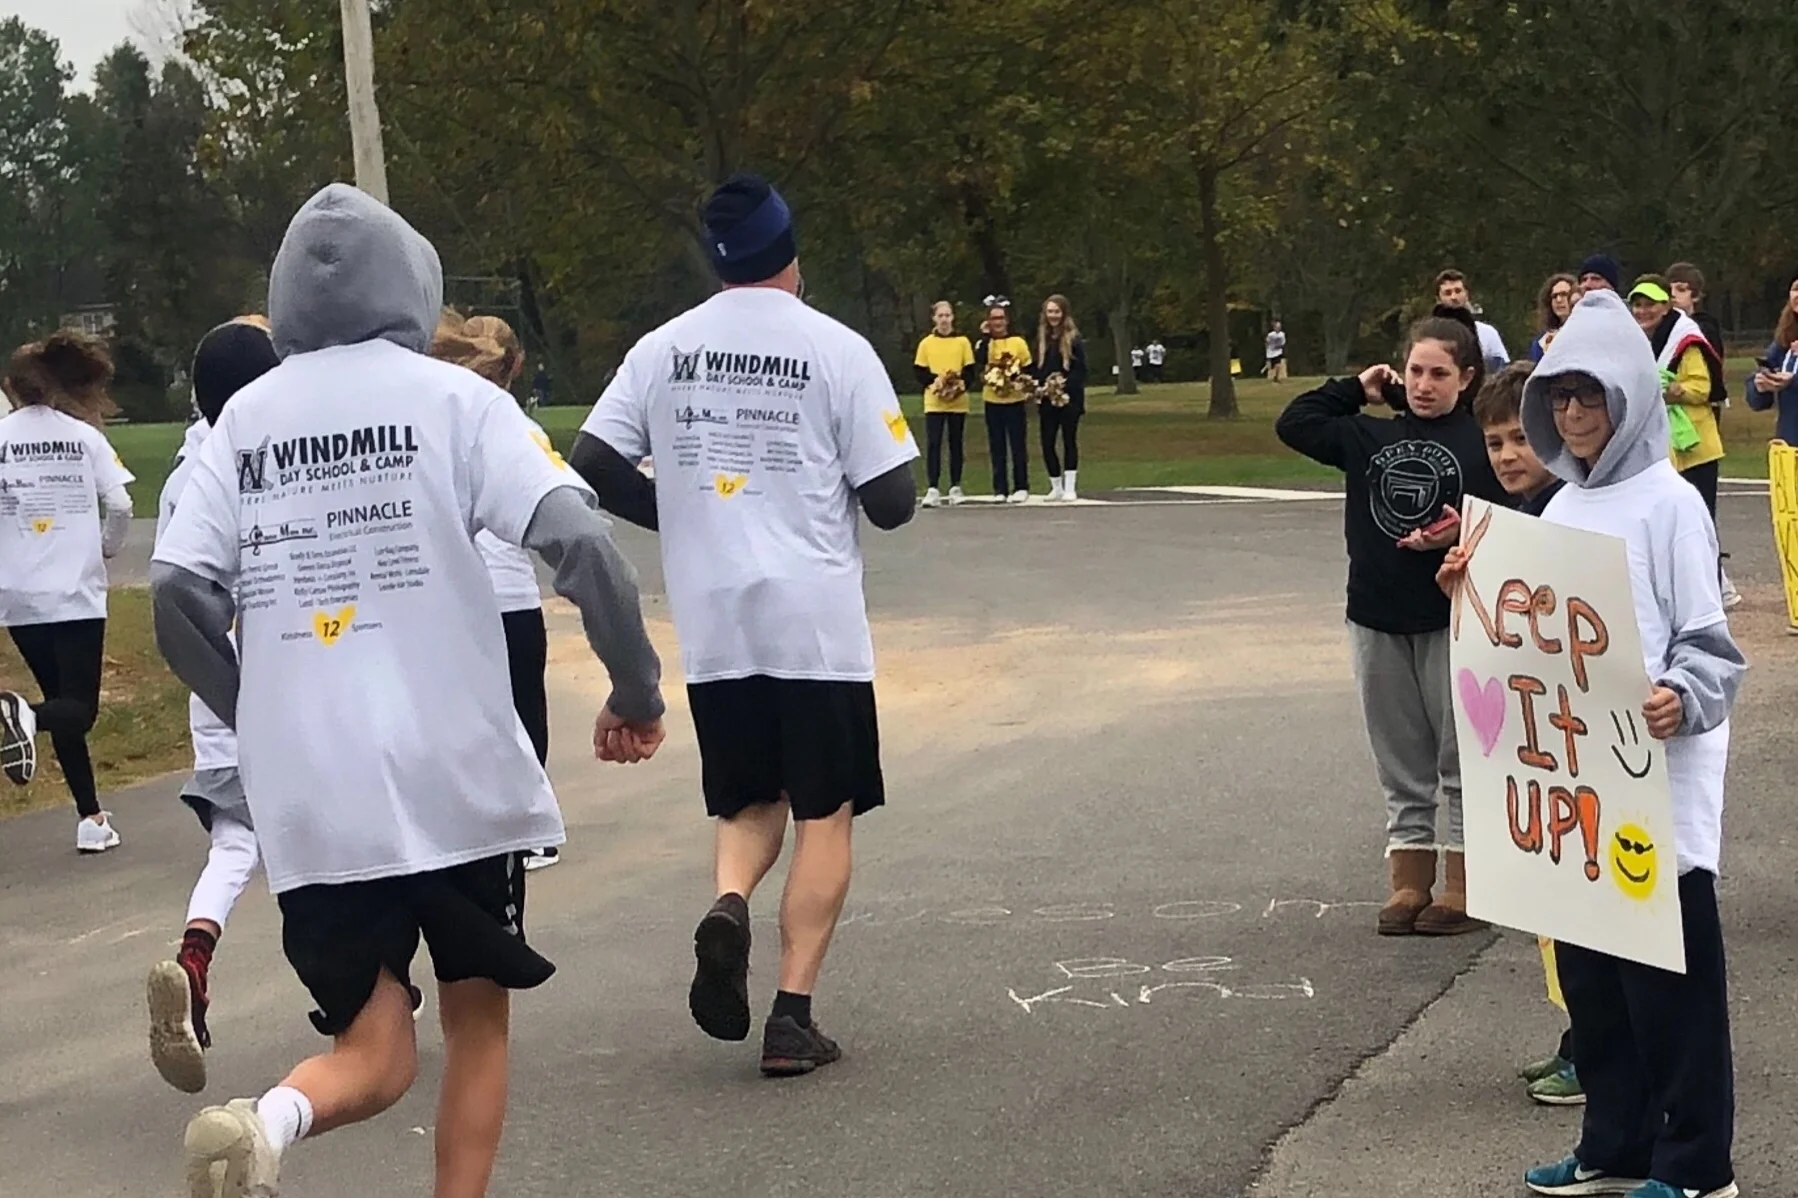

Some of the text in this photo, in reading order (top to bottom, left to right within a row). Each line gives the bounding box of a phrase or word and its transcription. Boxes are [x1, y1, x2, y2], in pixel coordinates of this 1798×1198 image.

[705, 351, 811, 380] WINDMILL
[706, 372, 806, 391] DAY SCHOOL & CAMP
[736, 408, 800, 425] PINNACLE
[10, 441, 84, 456] WINDMILL
[272, 425, 419, 470] WINDMILL
[280, 455, 414, 486] DAY SCHOOL & CAMP
[722, 482, 735, 494] 12
[327, 500, 413, 528] PINNACLE
[1453, 500, 1609, 693] Keep
[323, 620, 341, 638] 12
[1507, 674, 1589, 778] It
[1056, 955, 1237, 978] Be
[1005, 976, 1315, 1013] Kind
